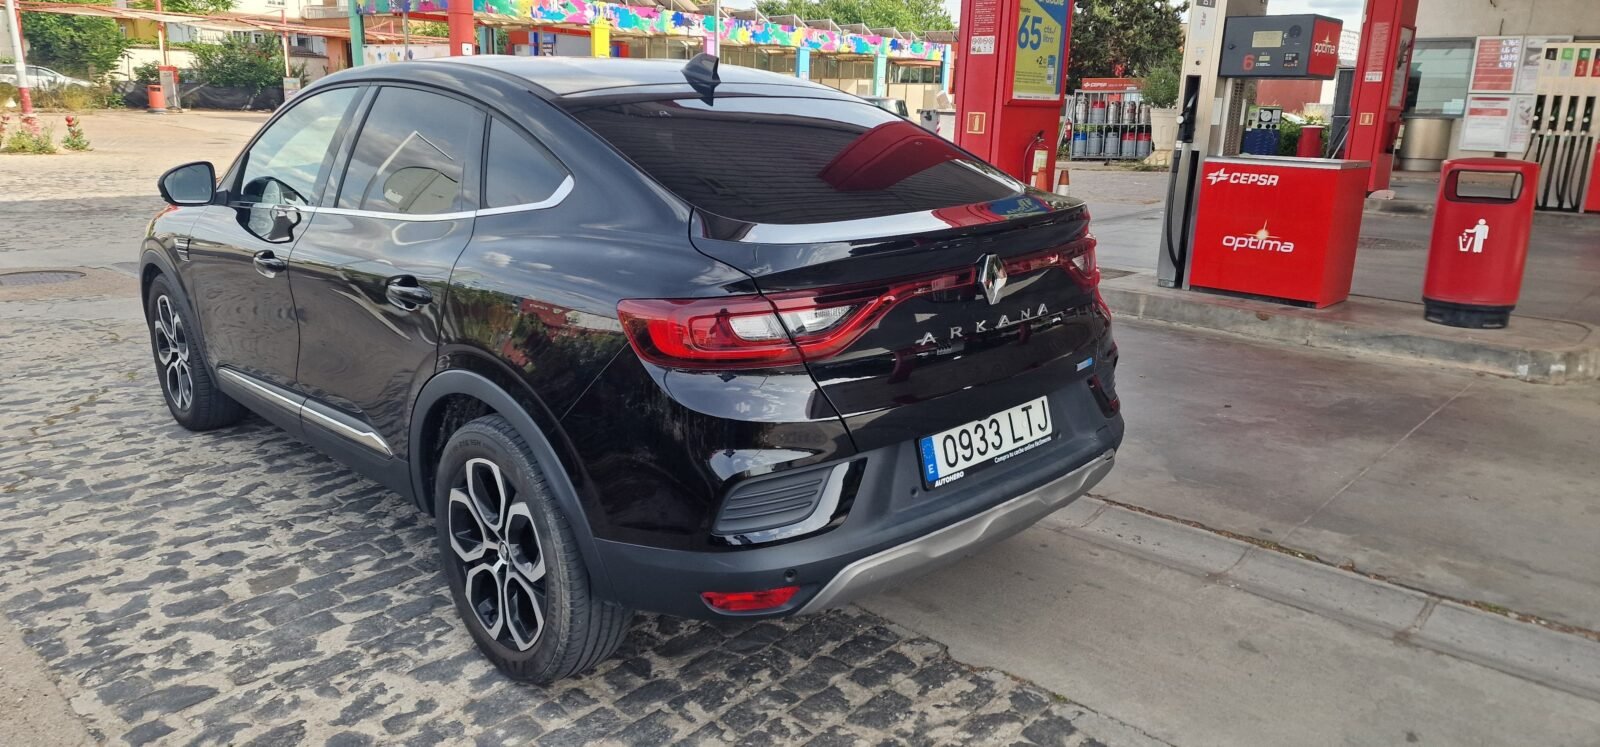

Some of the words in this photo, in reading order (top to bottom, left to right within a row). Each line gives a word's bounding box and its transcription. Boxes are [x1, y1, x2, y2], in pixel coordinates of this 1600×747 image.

[1018, 15, 1042, 50] 65
[1314, 43, 1336, 56] optima
[1243, 54, 1255, 71] 6
[1229, 172, 1279, 187] CEPSA
[1222, 235, 1295, 253] optima
[920, 303, 1049, 346] ARKANA
[943, 418, 1003, 468] 0933
[1008, 400, 1048, 444] LTJ
[928, 463, 935, 474] E
[934, 471, 965, 488] AUTOHERO
